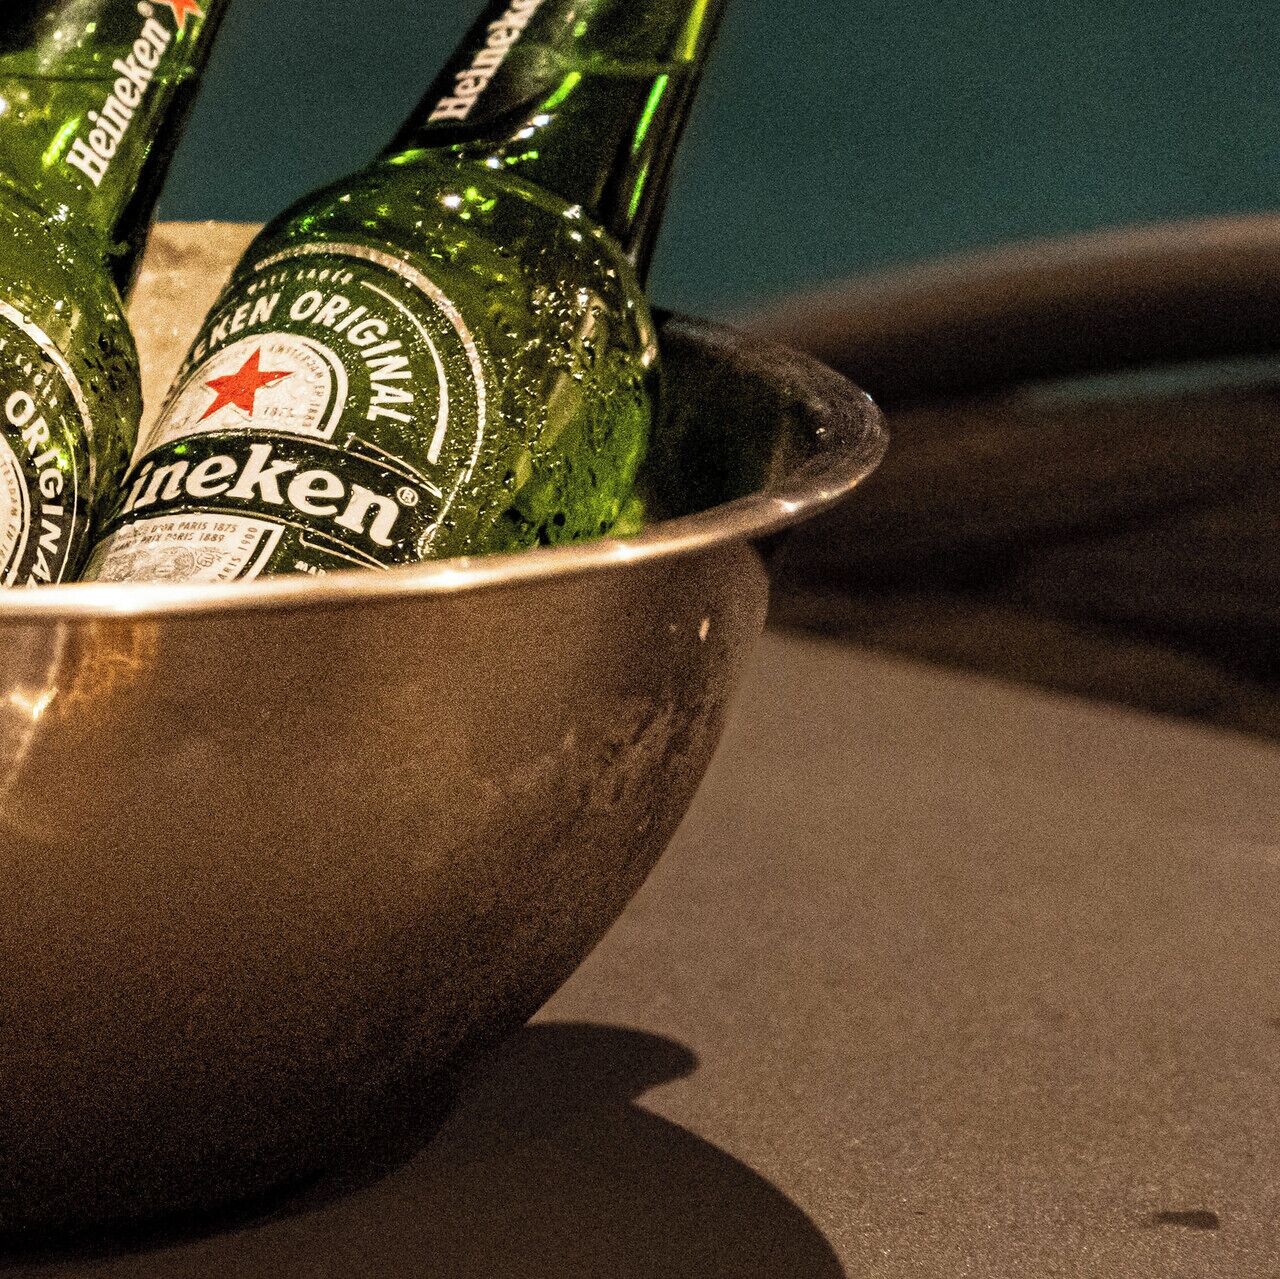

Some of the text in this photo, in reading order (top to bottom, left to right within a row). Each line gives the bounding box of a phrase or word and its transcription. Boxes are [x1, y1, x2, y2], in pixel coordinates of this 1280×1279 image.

[66, 17, 171, 188] Heineken
[289, 290, 415, 423] ORIGINAL
[178, 521, 209, 532] PARIS
[213, 522, 237, 533] 1875
